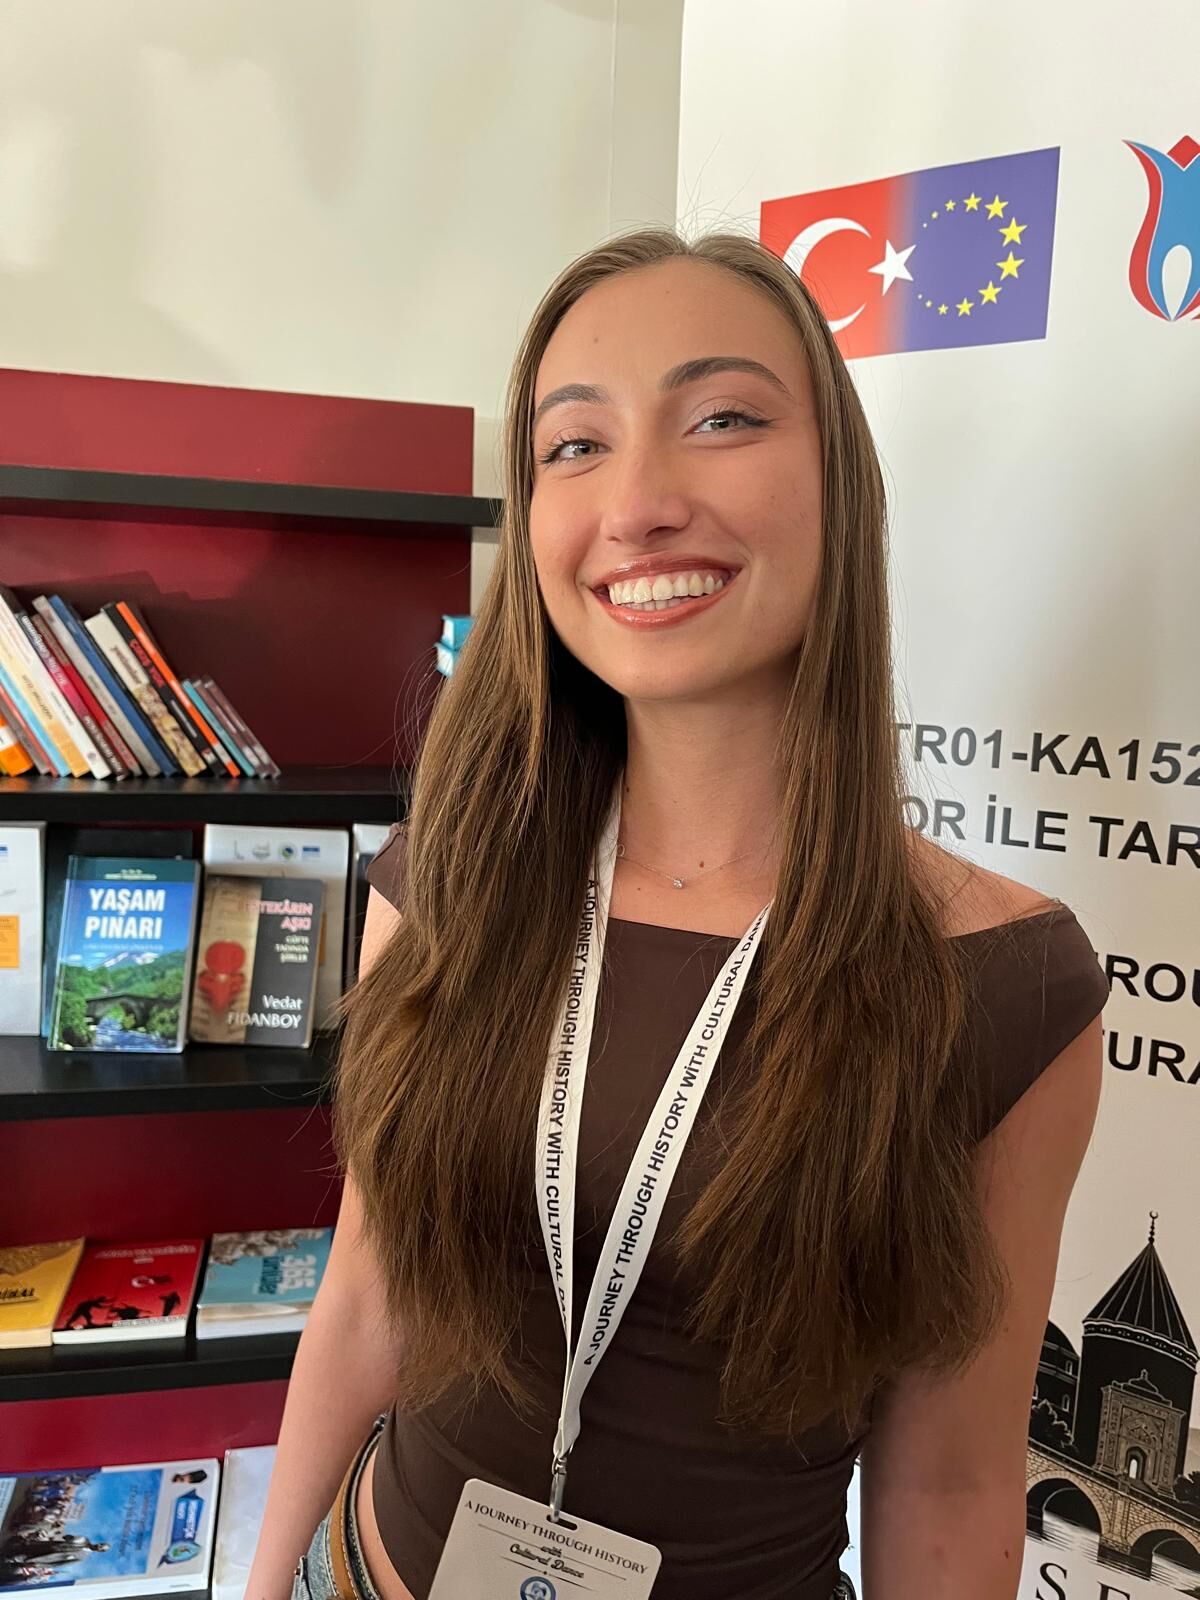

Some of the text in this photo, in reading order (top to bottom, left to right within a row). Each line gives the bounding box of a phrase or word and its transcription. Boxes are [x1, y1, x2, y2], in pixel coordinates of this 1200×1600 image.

[985, 794, 1069, 853] İLE
[1089, 815, 1200, 869] TAR
[85, 916, 163, 940] PINARI
[89, 888, 166, 916] YAŞAM
[575, 894, 596, 963] JOURNEY
[263, 995, 303, 1010] Vedat
[561, 966, 585, 1045] THROUGH
[1094, 952, 1200, 1008] RO
[1103, 1029, 1200, 1085] UR
[549, 1051, 572, 1127] HISTORY
[546, 1131, 564, 1179] WİTH
[584, 1350, 596, 1366] A
[590, 1268, 626, 1351] JOURNEY
[616, 1174, 658, 1266] THROUGH
[648, 1091, 689, 1171] HISTORY
[679, 1044, 709, 1091] WİTH
[702, 955, 746, 1041] CULTURAL
[546, 1185, 564, 1282] CULTURAL
[464, 1500, 648, 1575] A JOURNEY THROUGH HISTORY
[509, 1543, 585, 1579] Cultural Dance
